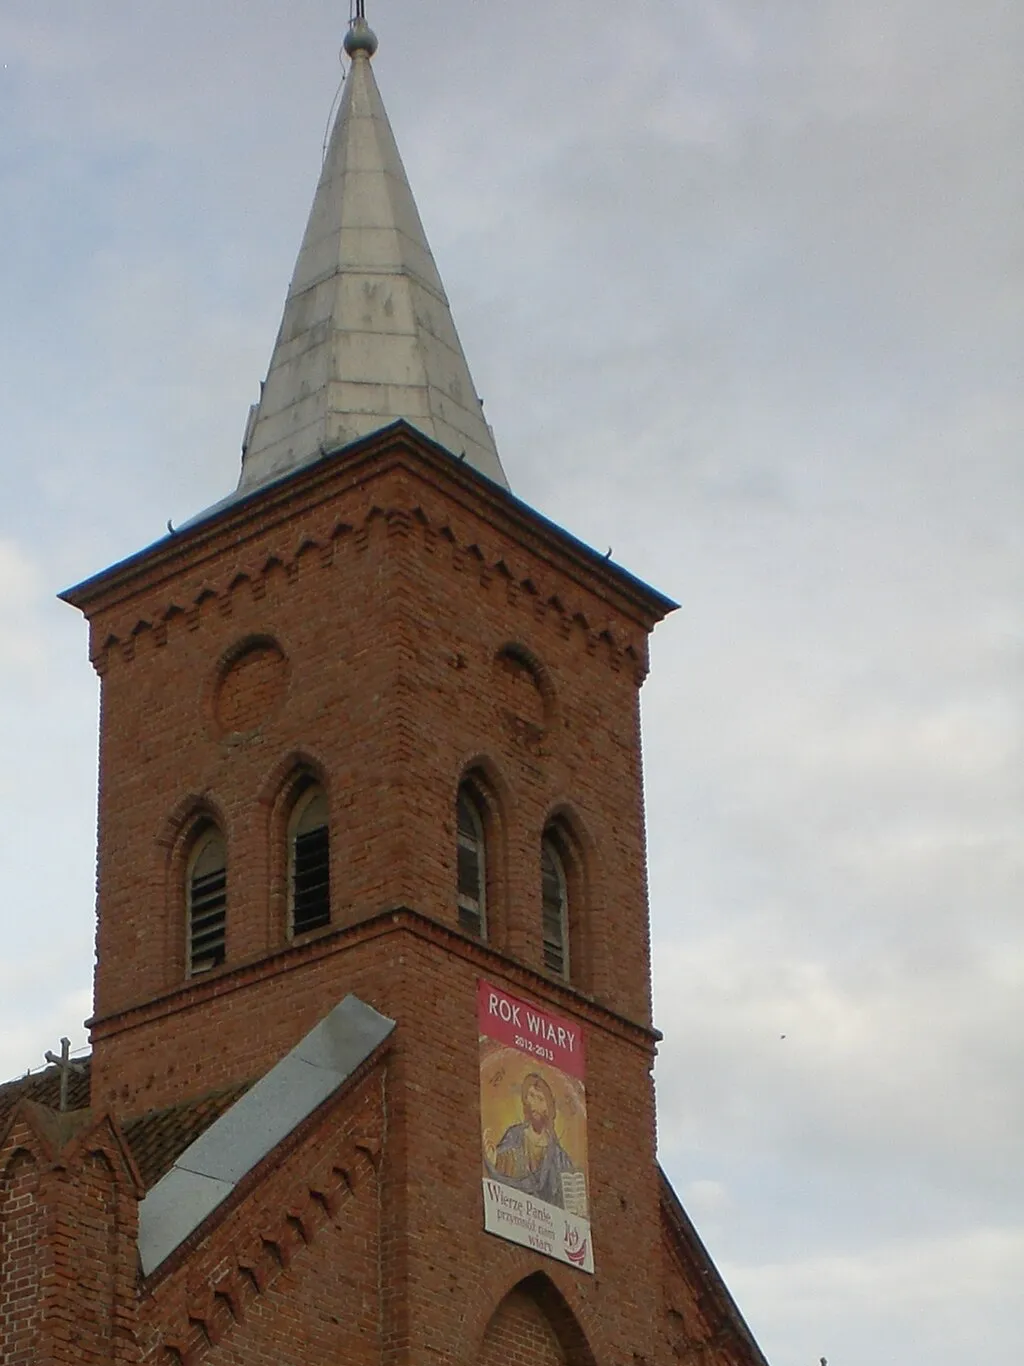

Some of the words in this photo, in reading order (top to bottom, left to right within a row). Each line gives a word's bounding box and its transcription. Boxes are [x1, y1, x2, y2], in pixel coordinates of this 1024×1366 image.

[489, 993, 521, 1028] ROK
[527, 1012, 575, 1052] WIARY
[515, 1035, 554, 1061] 2012-2013
